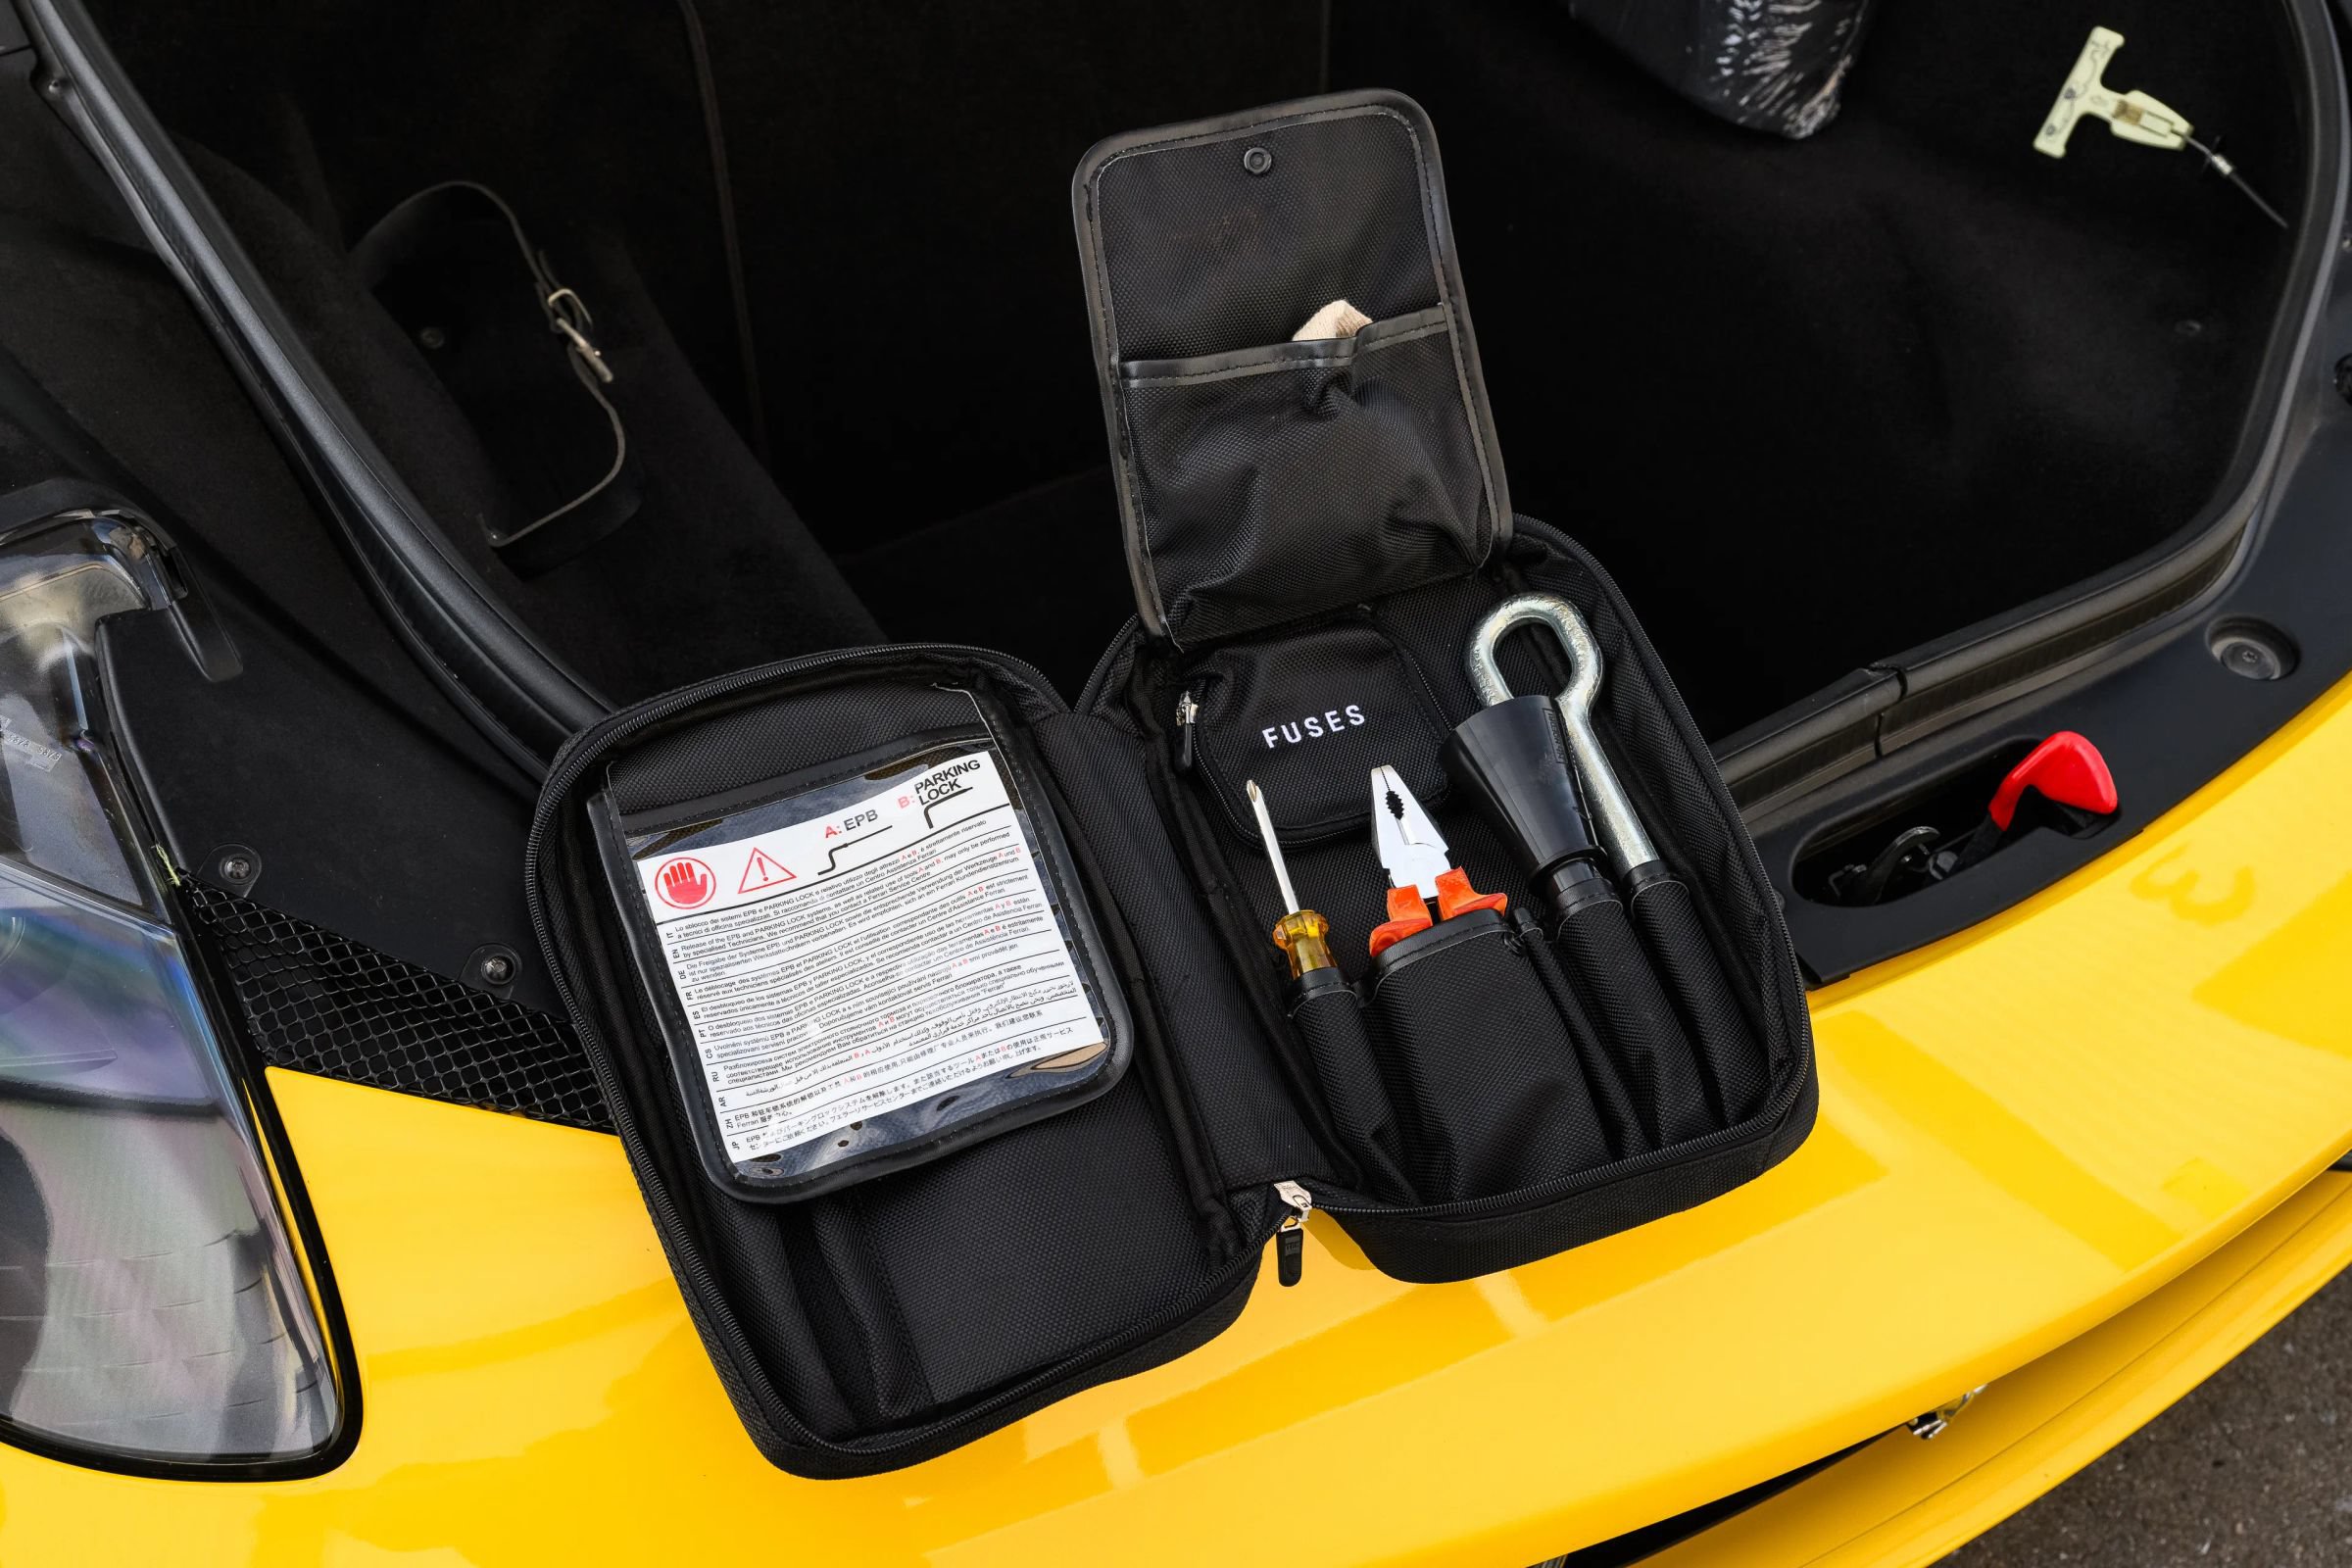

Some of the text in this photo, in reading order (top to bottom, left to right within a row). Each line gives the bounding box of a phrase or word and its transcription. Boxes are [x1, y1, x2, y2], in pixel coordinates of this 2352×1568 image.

[1261, 705, 1365, 749] FUSES
[898, 760, 981, 808] B: PARKING
[918, 778, 961, 806] LOCK
[824, 808, 879, 838] A: EPB
[680, 941, 706, 951] Release
[754, 920, 785, 933] PARKING
[786, 914, 805, 924] LOCK
[924, 861, 935, 870] and
[943, 852, 956, 860] may
[957, 846, 969, 854] only
[979, 831, 1010, 846] performed
[742, 908, 757, 916] EPB
[763, 897, 794, 911] PARKING
[794, 891, 814, 902] LOCK
[778, 918, 814, 934] recommend
[840, 900, 862, 912] contact
[867, 890, 887, 901] Ferrari
[888, 880, 910, 892] Service
[911, 871, 930, 882] Centre
[765, 941, 780, 950] EPB
[794, 926, 824, 941] PARKING
[825, 918, 844, 930] LOCK
[671, 948, 680, 959] EN
[780, 963, 794, 972] EPB
[802, 949, 833, 964] PARKING
[833, 940, 852, 952] LOCK
[677, 969, 686, 979] DE
[793, 980, 807, 990] EPB
[812, 965, 843, 981] PARKING
[685, 990, 693, 1000] FR
[794, 1001, 808, 1011] EPB
[813, 985, 844, 1001] PARKING
[844, 977, 863, 989] LOCK
[691, 1010, 700, 1019] ES
[697, 1029, 706, 1037] PT
[769, 1031, 784, 1040] EPB
[821, 1008, 841, 1019] LOCK
[704, 1048, 713, 1058] CS
[710, 1071, 719, 1082] RU
[718, 1096, 727, 1107] AR
[724, 1118, 733, 1129] ZH
[734, 1112, 749, 1121] EPB
[731, 1141, 740, 1150] JP
[745, 1134, 760, 1142] EPB
